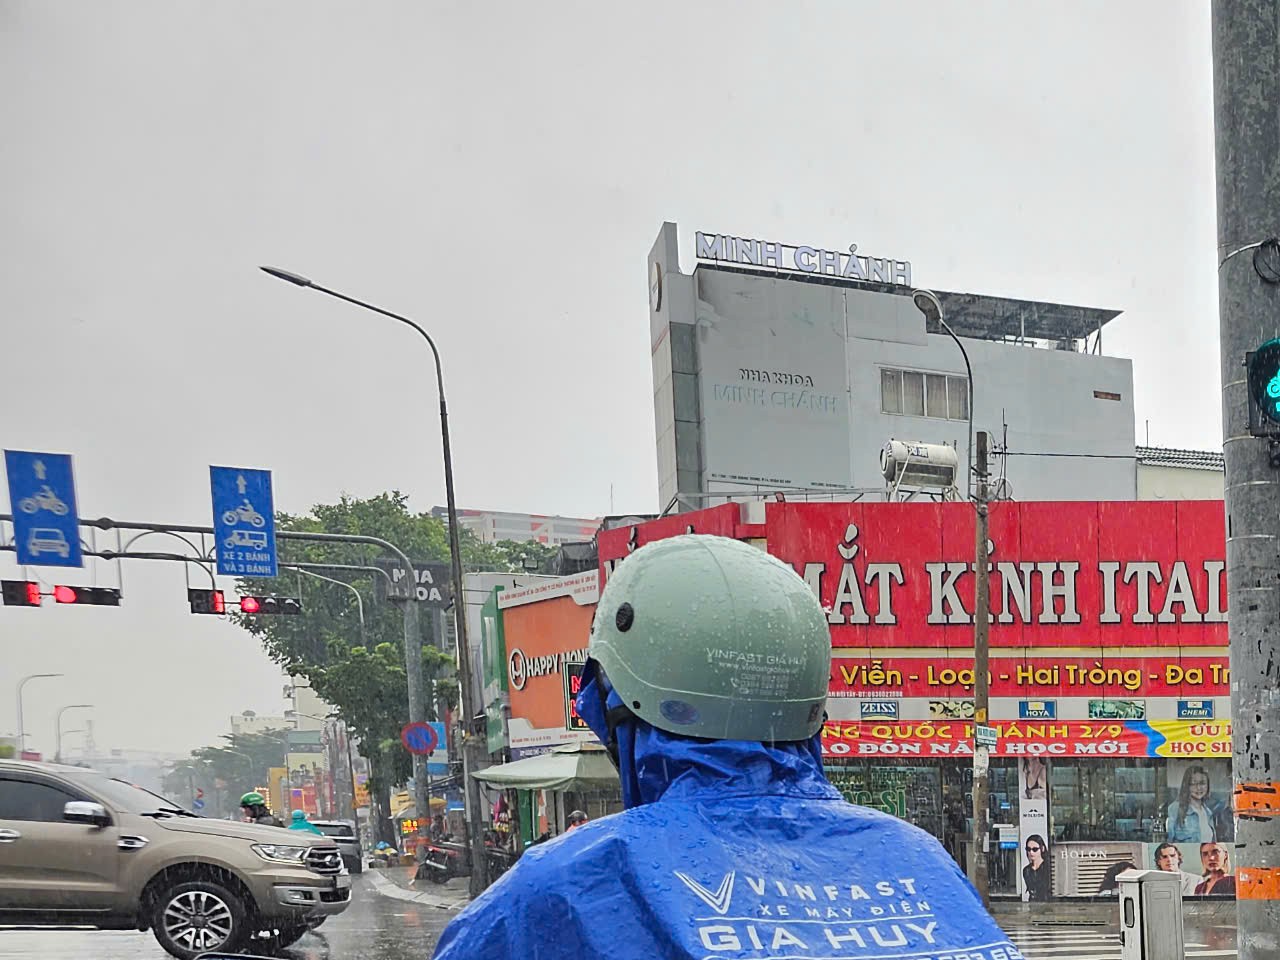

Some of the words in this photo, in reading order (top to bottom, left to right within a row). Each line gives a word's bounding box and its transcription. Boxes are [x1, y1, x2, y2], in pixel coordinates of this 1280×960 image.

[695, 231, 783, 269] MINH
[739, 368, 771, 383] NHA
[772, 372, 814, 387] KHOA
[223, 551, 236, 560] XE
[237, 552, 244, 560] 2
[393, 568, 434, 584] NA
[706, 647, 764, 662] VINFAST
[526, 653, 559, 677] HAPPY
[840, 660, 902, 685] Viễn
[1017, 665, 1059, 685] Hai
[1066, 661, 1142, 690] Tròng
[1165, 665, 1203, 685] Đa
[861, 702, 896, 713] ZEISS
[1025, 709, 1050, 717] HOYA
[871, 721, 953, 740] QUỐC
[1079, 725, 1123, 738] 2/9
[1190, 722, 1220, 736] ƯU
[858, 740, 922, 754] ĐÓN
[1005, 743, 1067, 757] HỌC
[1075, 739, 1129, 754] MỚI
[1171, 742, 1206, 755] HỌC
[1061, 850, 1107, 859] BOLON
[745, 876, 917, 901] VINFAST
[759, 904, 790, 916] XE
[870, 898, 931, 915] ĐIỆN
[699, 925, 809, 951] GIA
[824, 921, 938, 950] HUY
